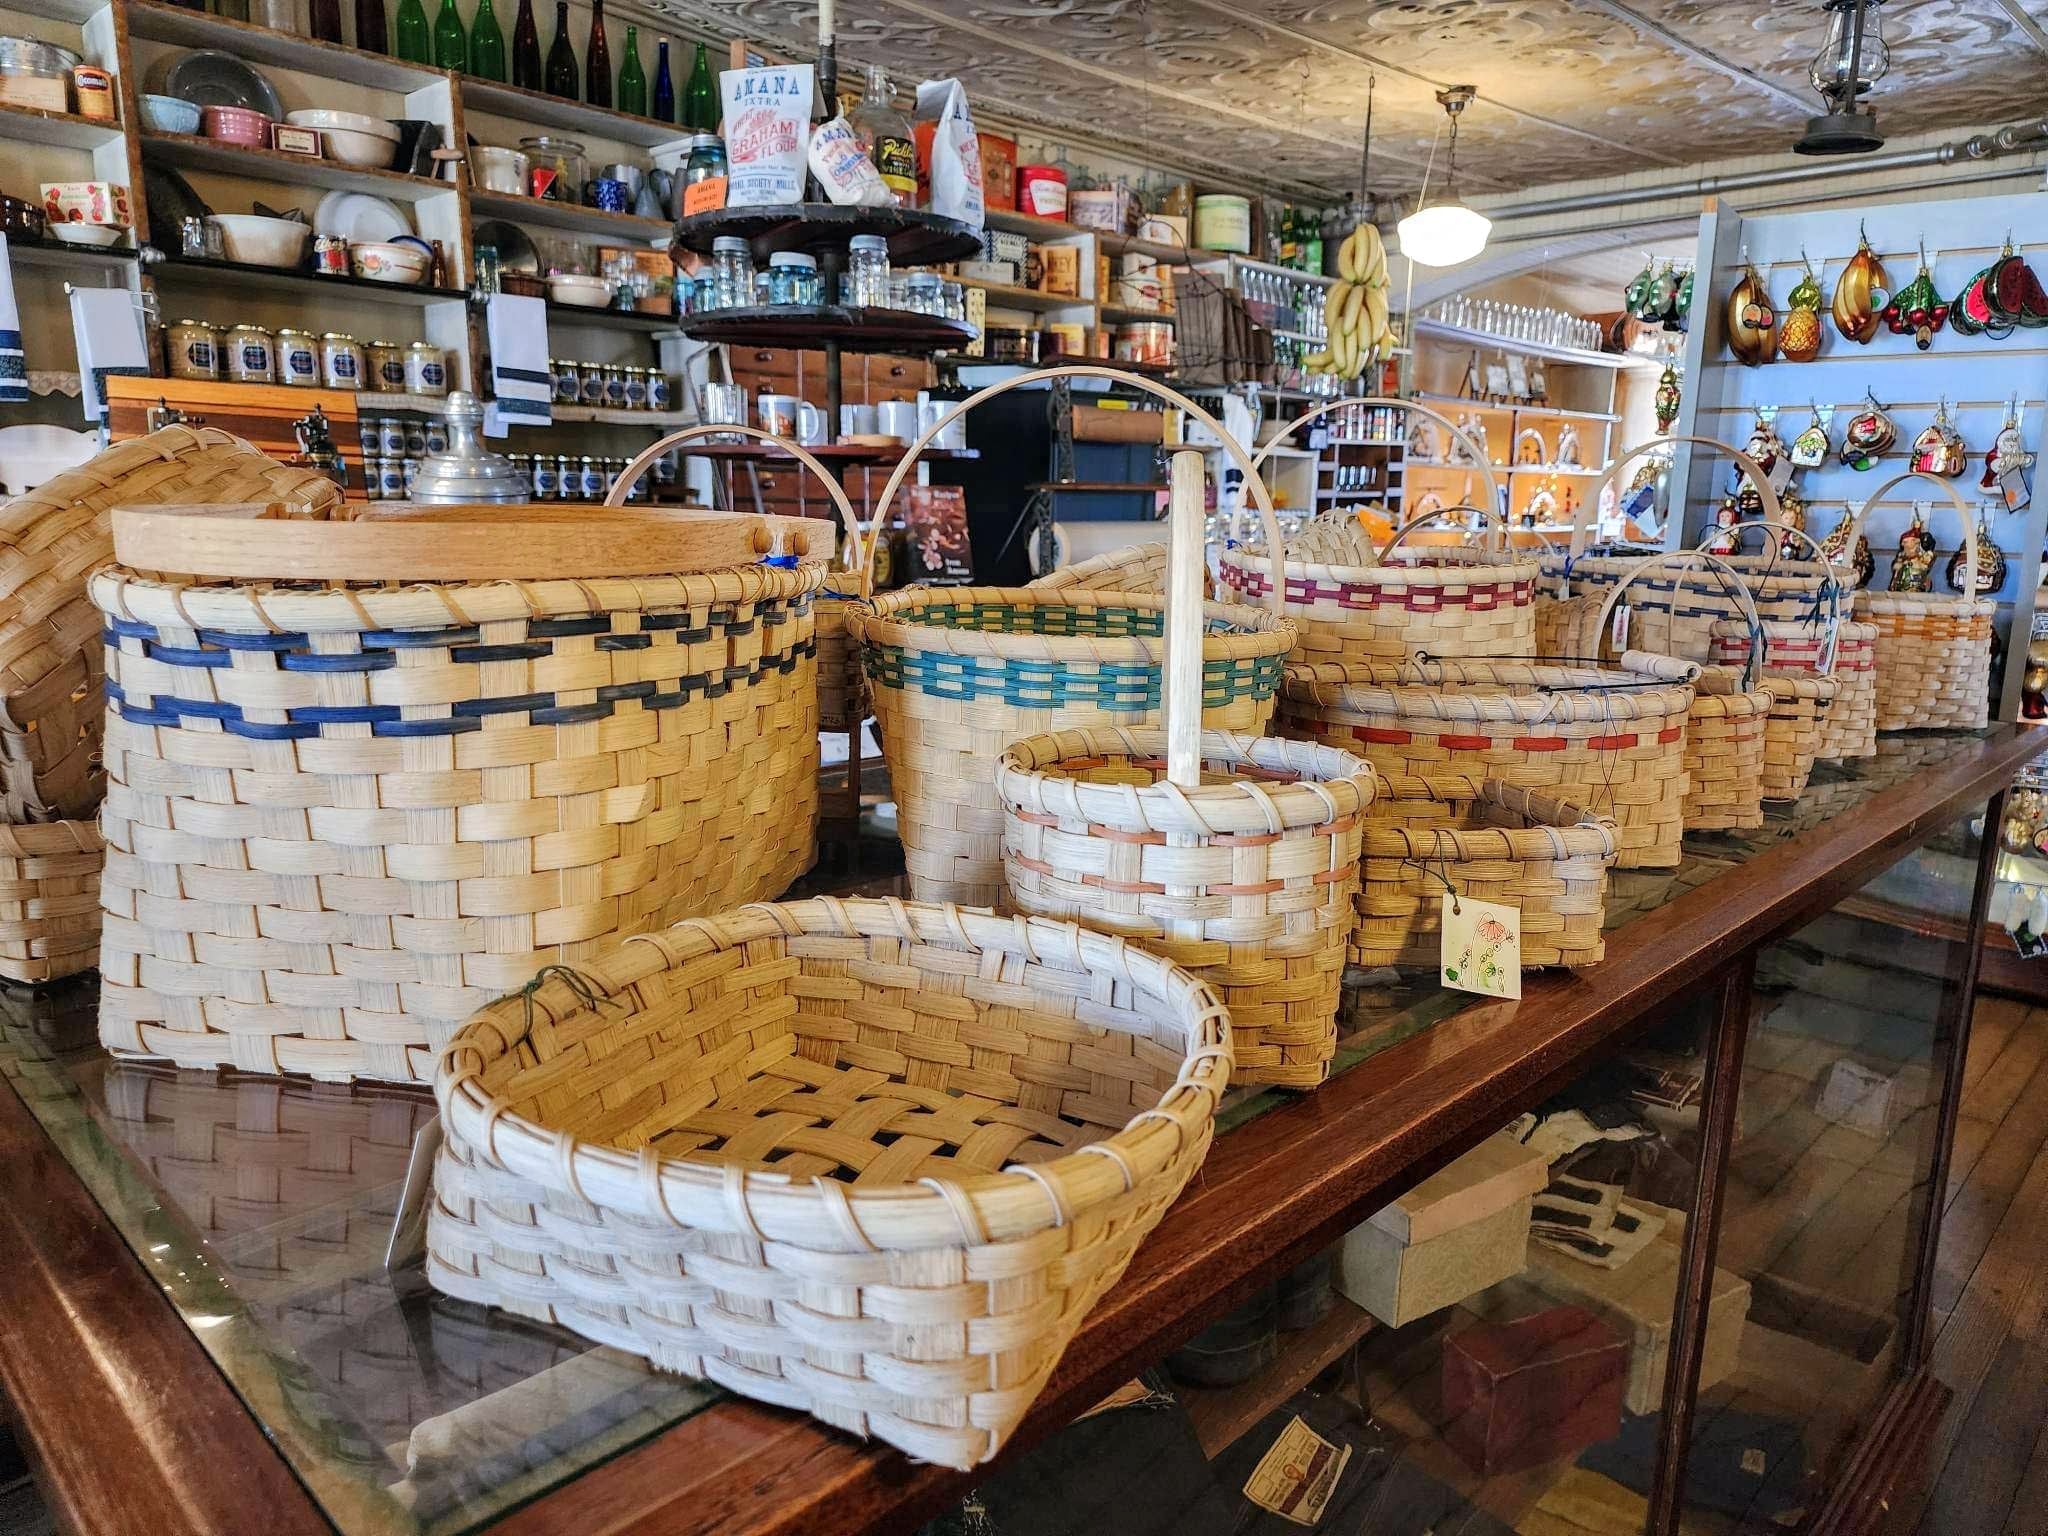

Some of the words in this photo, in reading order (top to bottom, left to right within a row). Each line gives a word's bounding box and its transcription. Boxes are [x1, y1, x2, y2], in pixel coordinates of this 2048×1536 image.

[734, 76, 800, 101] AMANA
[744, 97, 782, 106] EXTRA
[733, 121, 793, 155] GRAHAM
[761, 139, 797, 159] FLOUR
